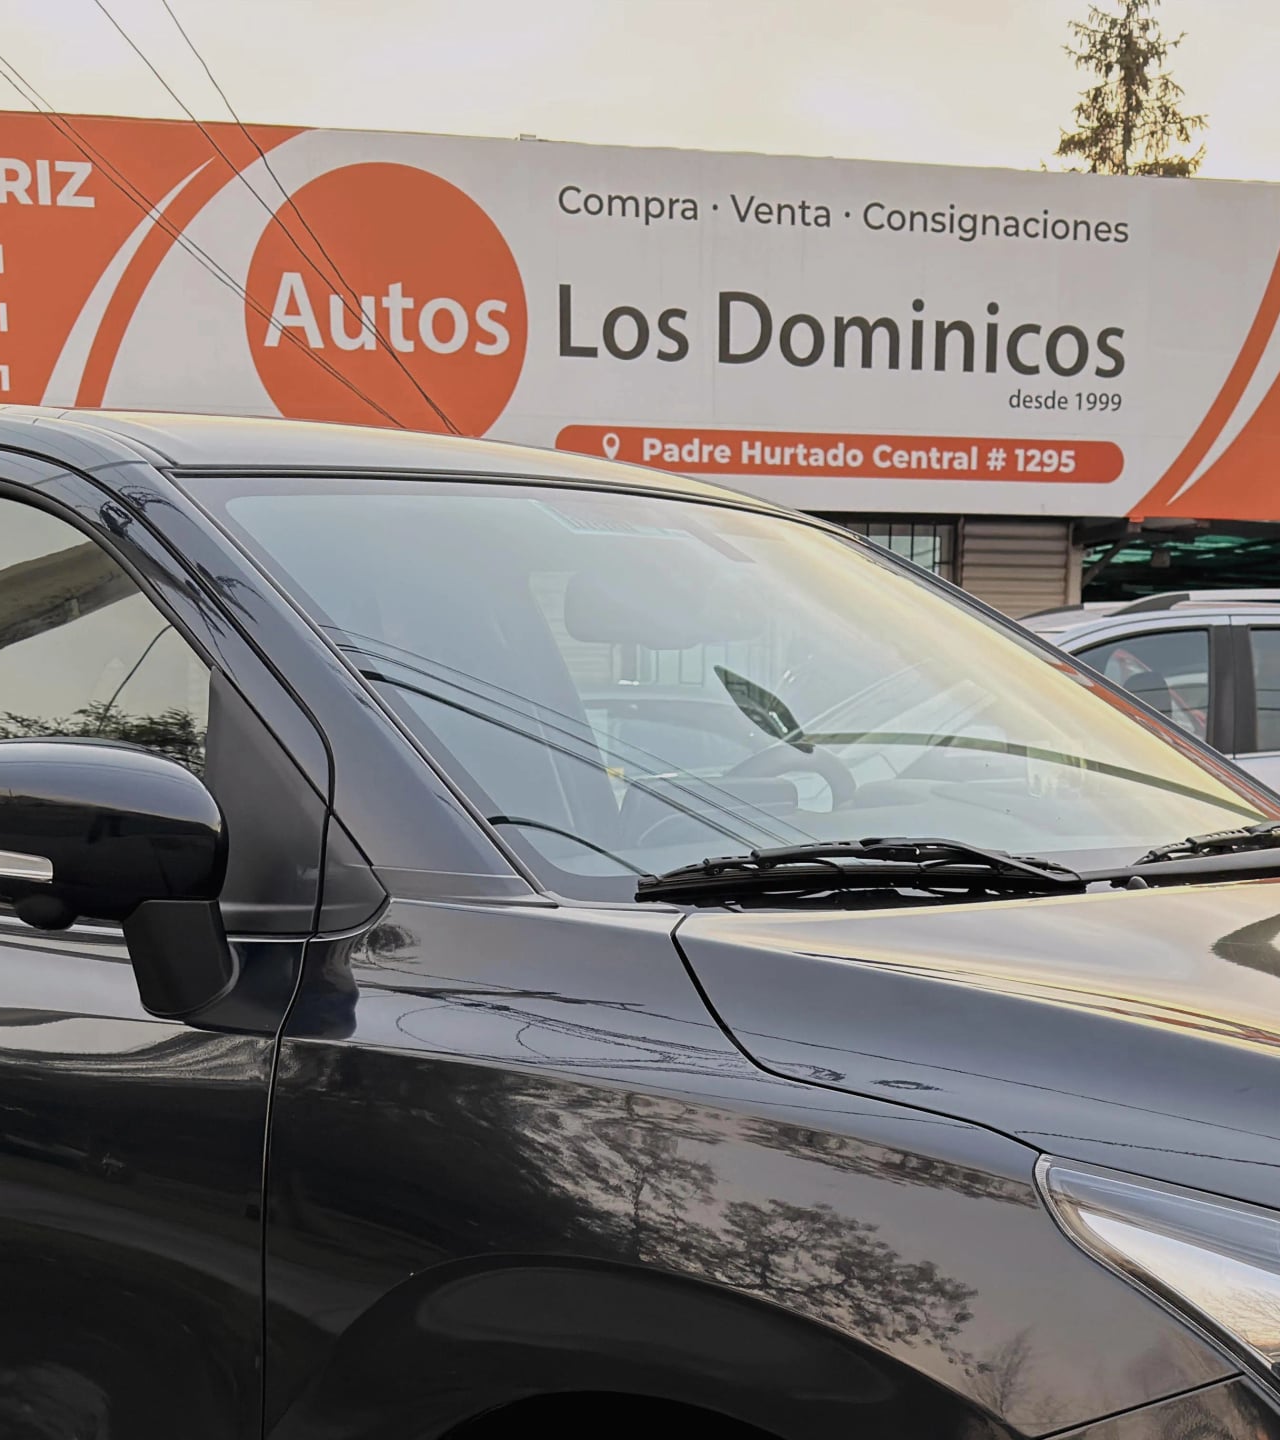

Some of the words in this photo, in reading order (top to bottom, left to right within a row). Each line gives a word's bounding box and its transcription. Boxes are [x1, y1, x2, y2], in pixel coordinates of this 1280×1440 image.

[558, 185, 699, 226] Compra
[729, 194, 832, 228] Venta
[863, 202, 1130, 243] Consignaciones
[263, 271, 511, 356] Autos
[559, 283, 690, 363] Los
[718, 291, 1126, 379] Dominicos
[1008, 388, 1070, 411] desde
[1074, 392, 1123, 413] 1999
[642, 437, 732, 464] Padre
[741, 440, 865, 468] Hurtado
[872, 444, 979, 471] Central
[1014, 448, 1077, 474] 1295
